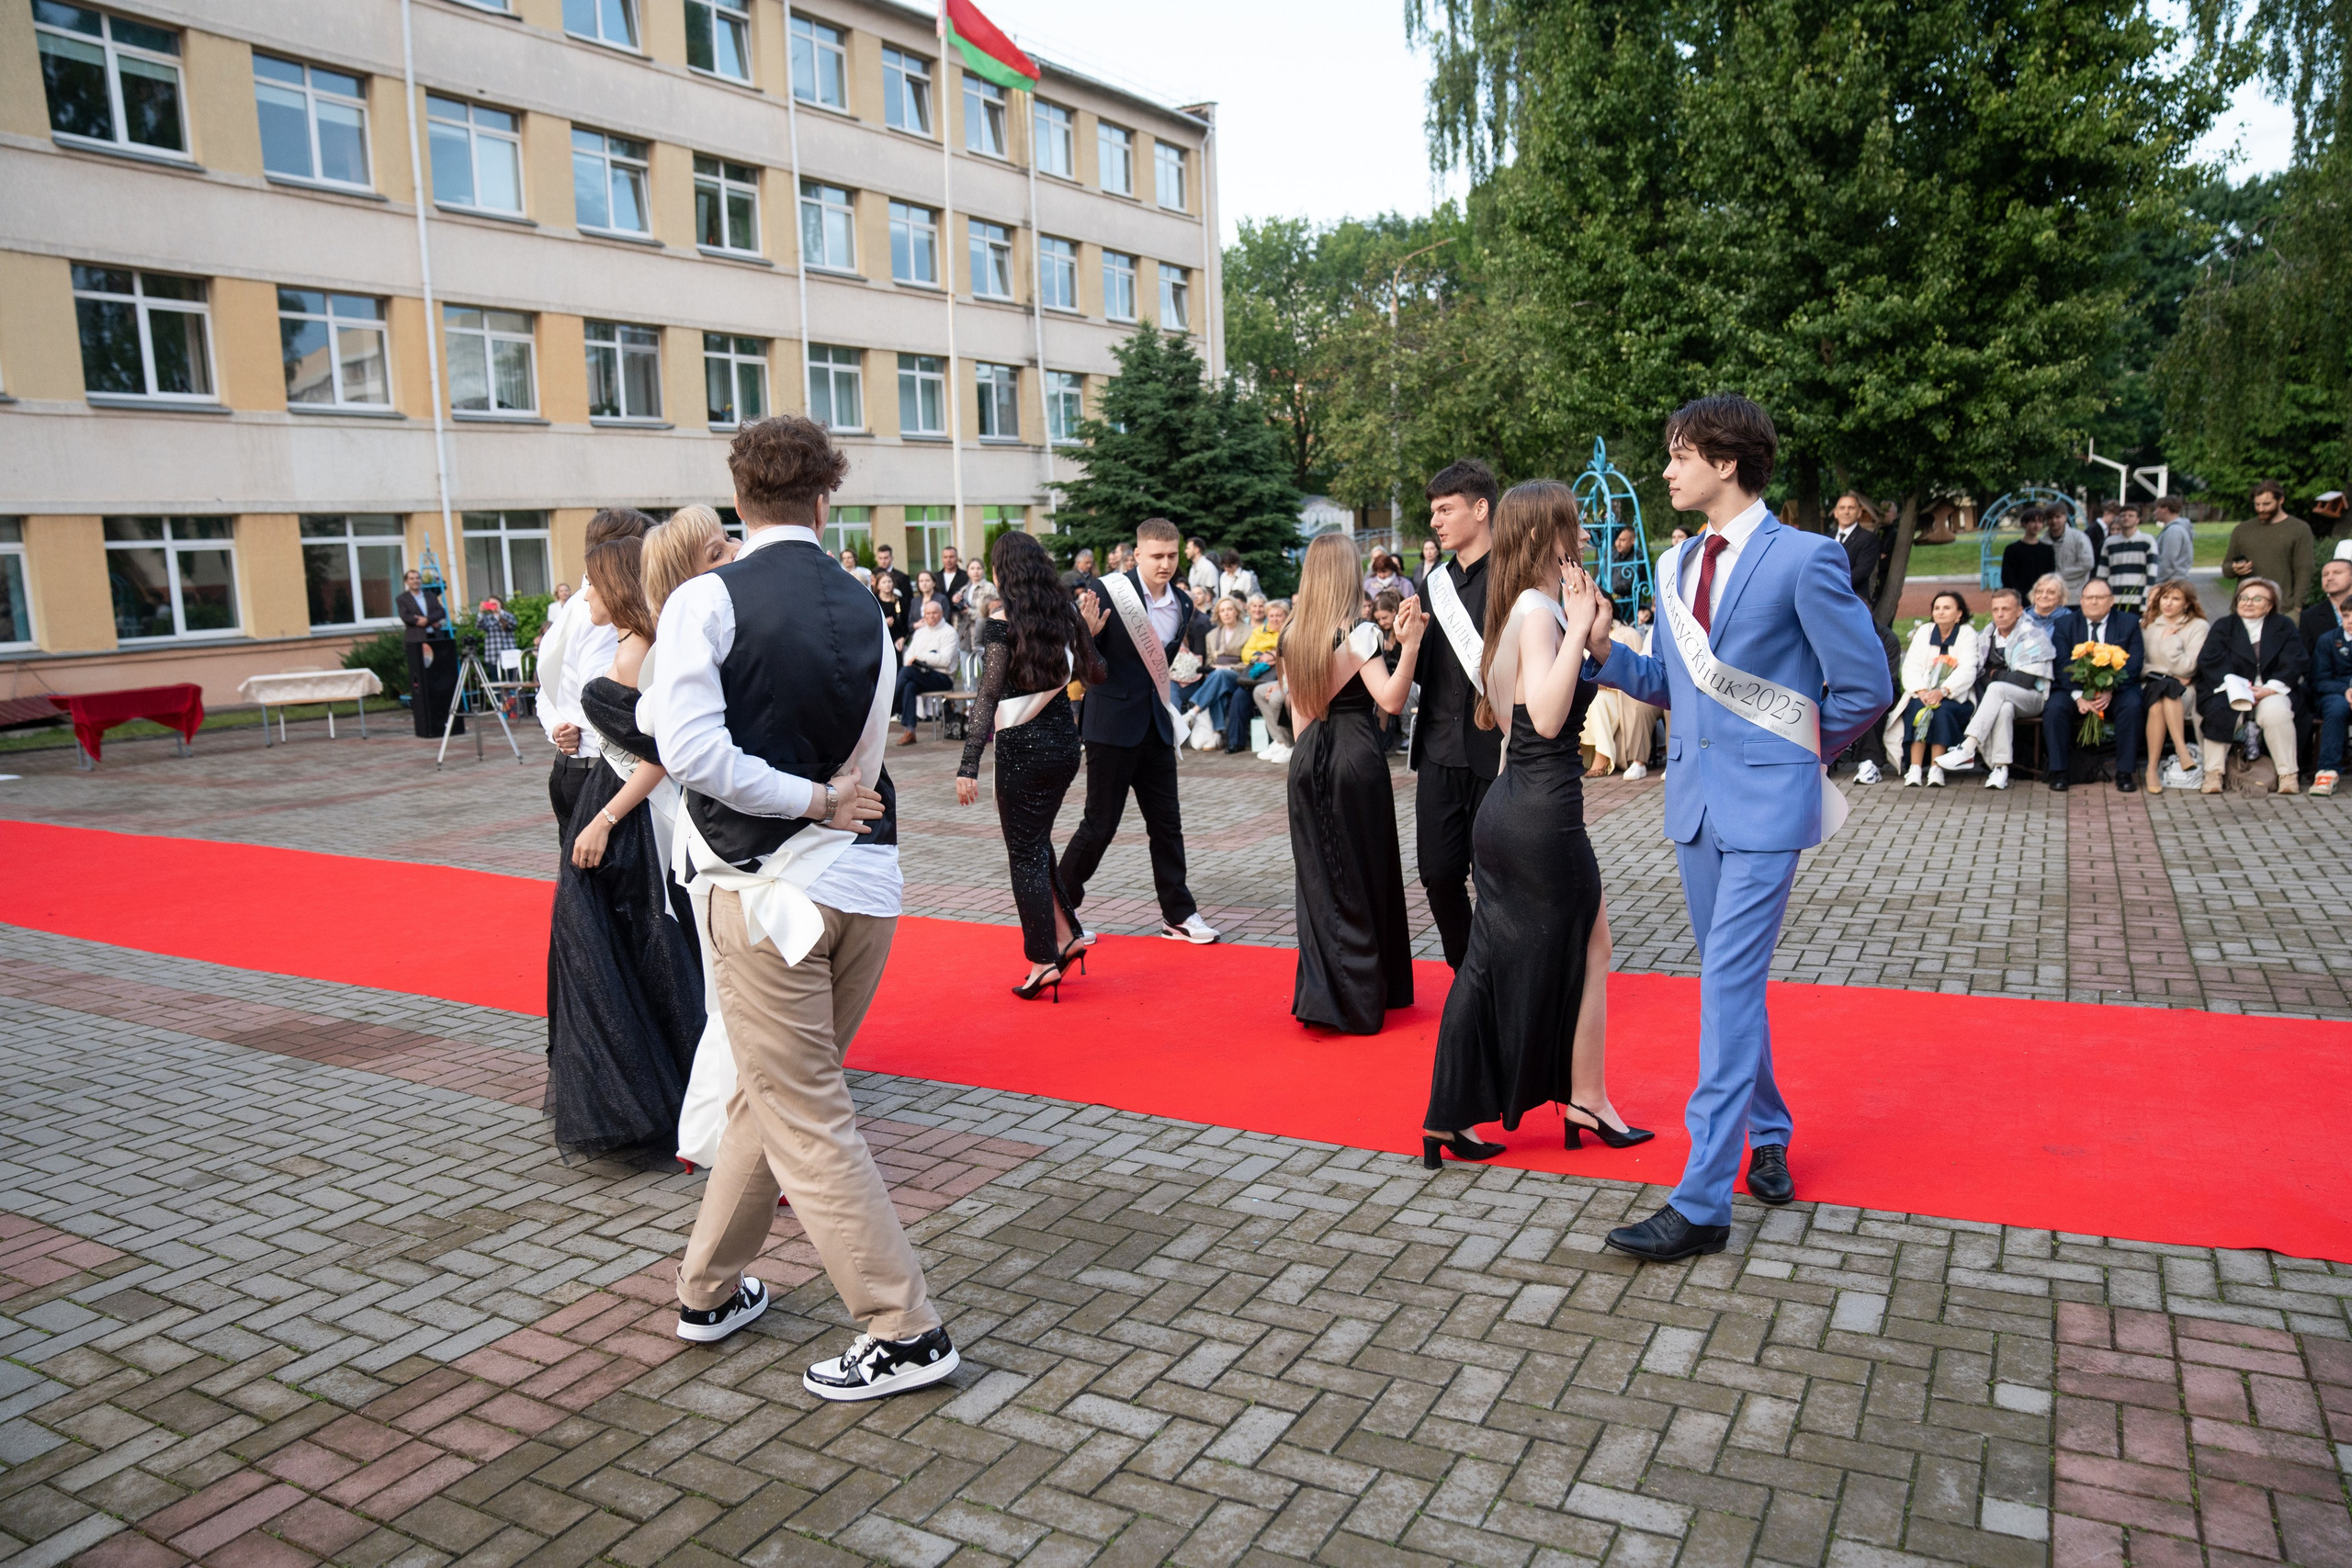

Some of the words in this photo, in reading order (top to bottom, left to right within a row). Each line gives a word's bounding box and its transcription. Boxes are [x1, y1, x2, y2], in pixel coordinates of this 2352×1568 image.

[1111, 576, 1157, 659] Выпускник
[1151, 654, 1170, 684] 2025
[1665, 571, 1742, 700] Выпускник
[1740, 681, 1807, 725] 2025
